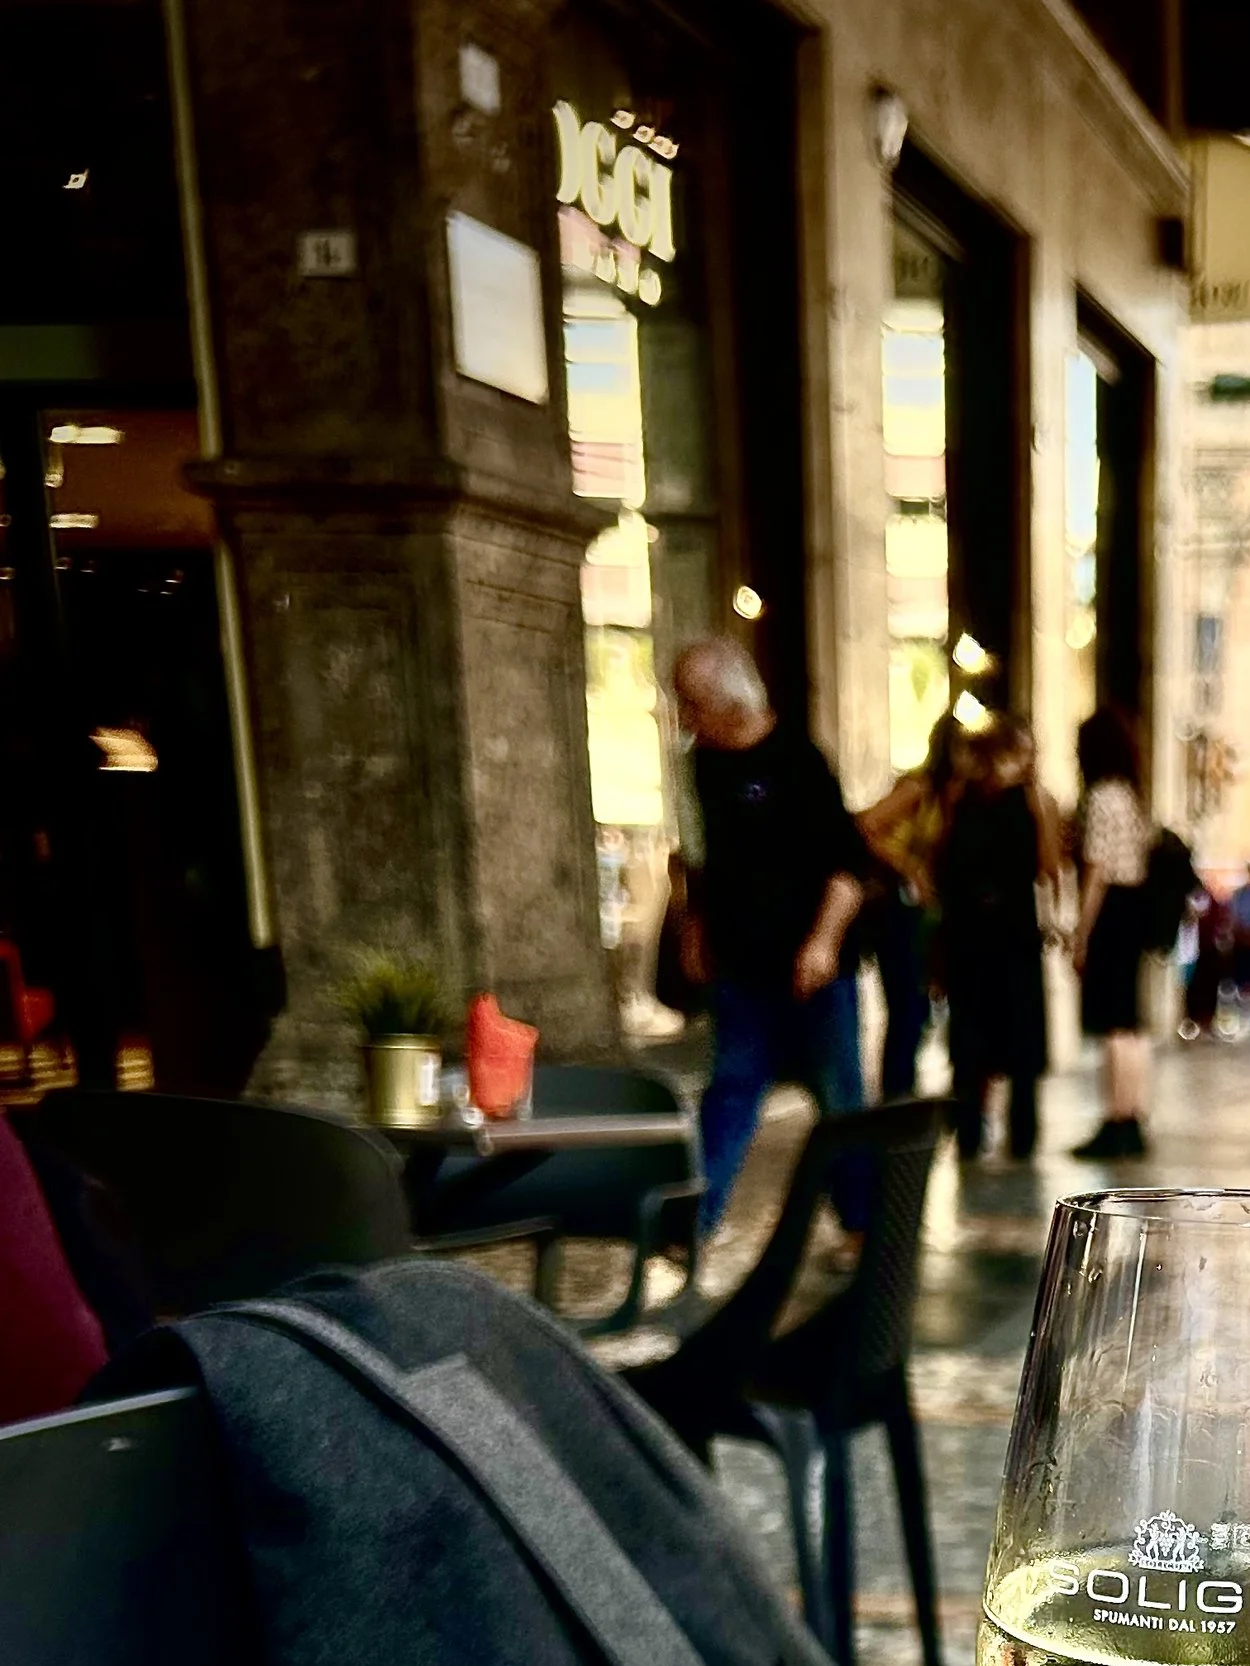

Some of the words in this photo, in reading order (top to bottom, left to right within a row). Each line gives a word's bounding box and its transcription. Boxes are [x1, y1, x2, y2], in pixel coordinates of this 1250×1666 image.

[1093, 1609, 1163, 1630] SPUMANTI
[1168, 1617, 1196, 1632] DAL
[1200, 1619, 1236, 1635] 1957
